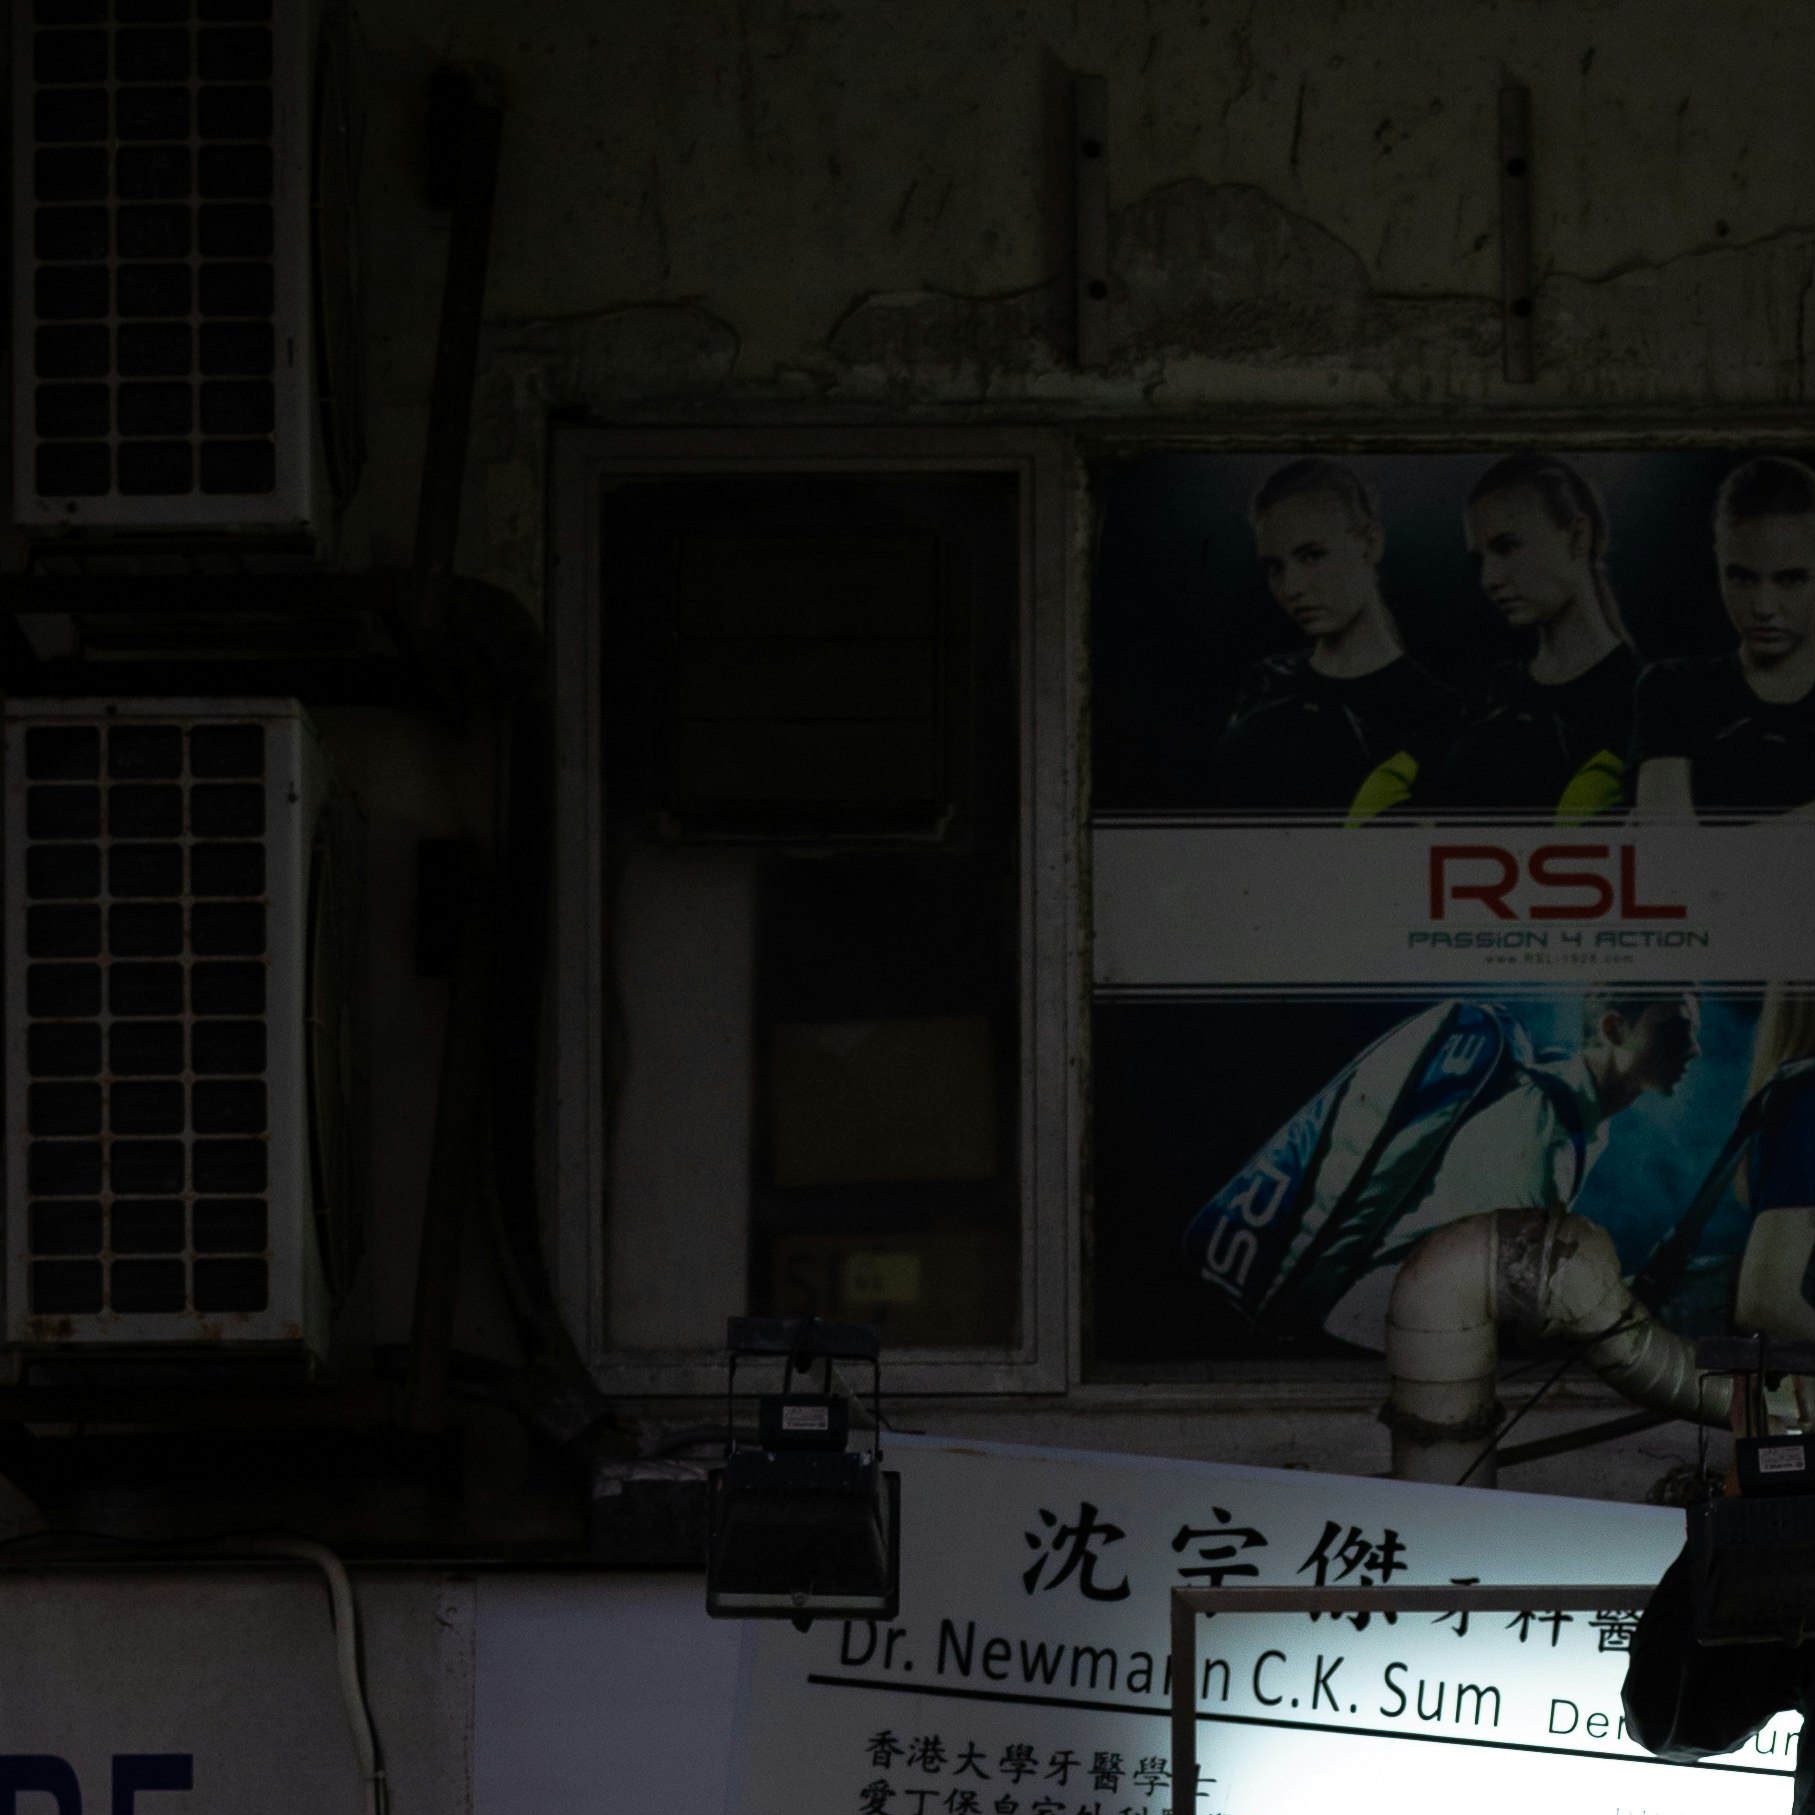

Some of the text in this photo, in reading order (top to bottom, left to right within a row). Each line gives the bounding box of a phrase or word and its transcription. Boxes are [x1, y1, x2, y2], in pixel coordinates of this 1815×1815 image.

[1430, 845, 1688, 920] RSL
[1560, 930, 1582, 947] 4
[840, 1619, 914, 1671] Dr.
[937, 1619, 1231, 1701] Newman
[1380, 1662, 1502, 1727] Sum
